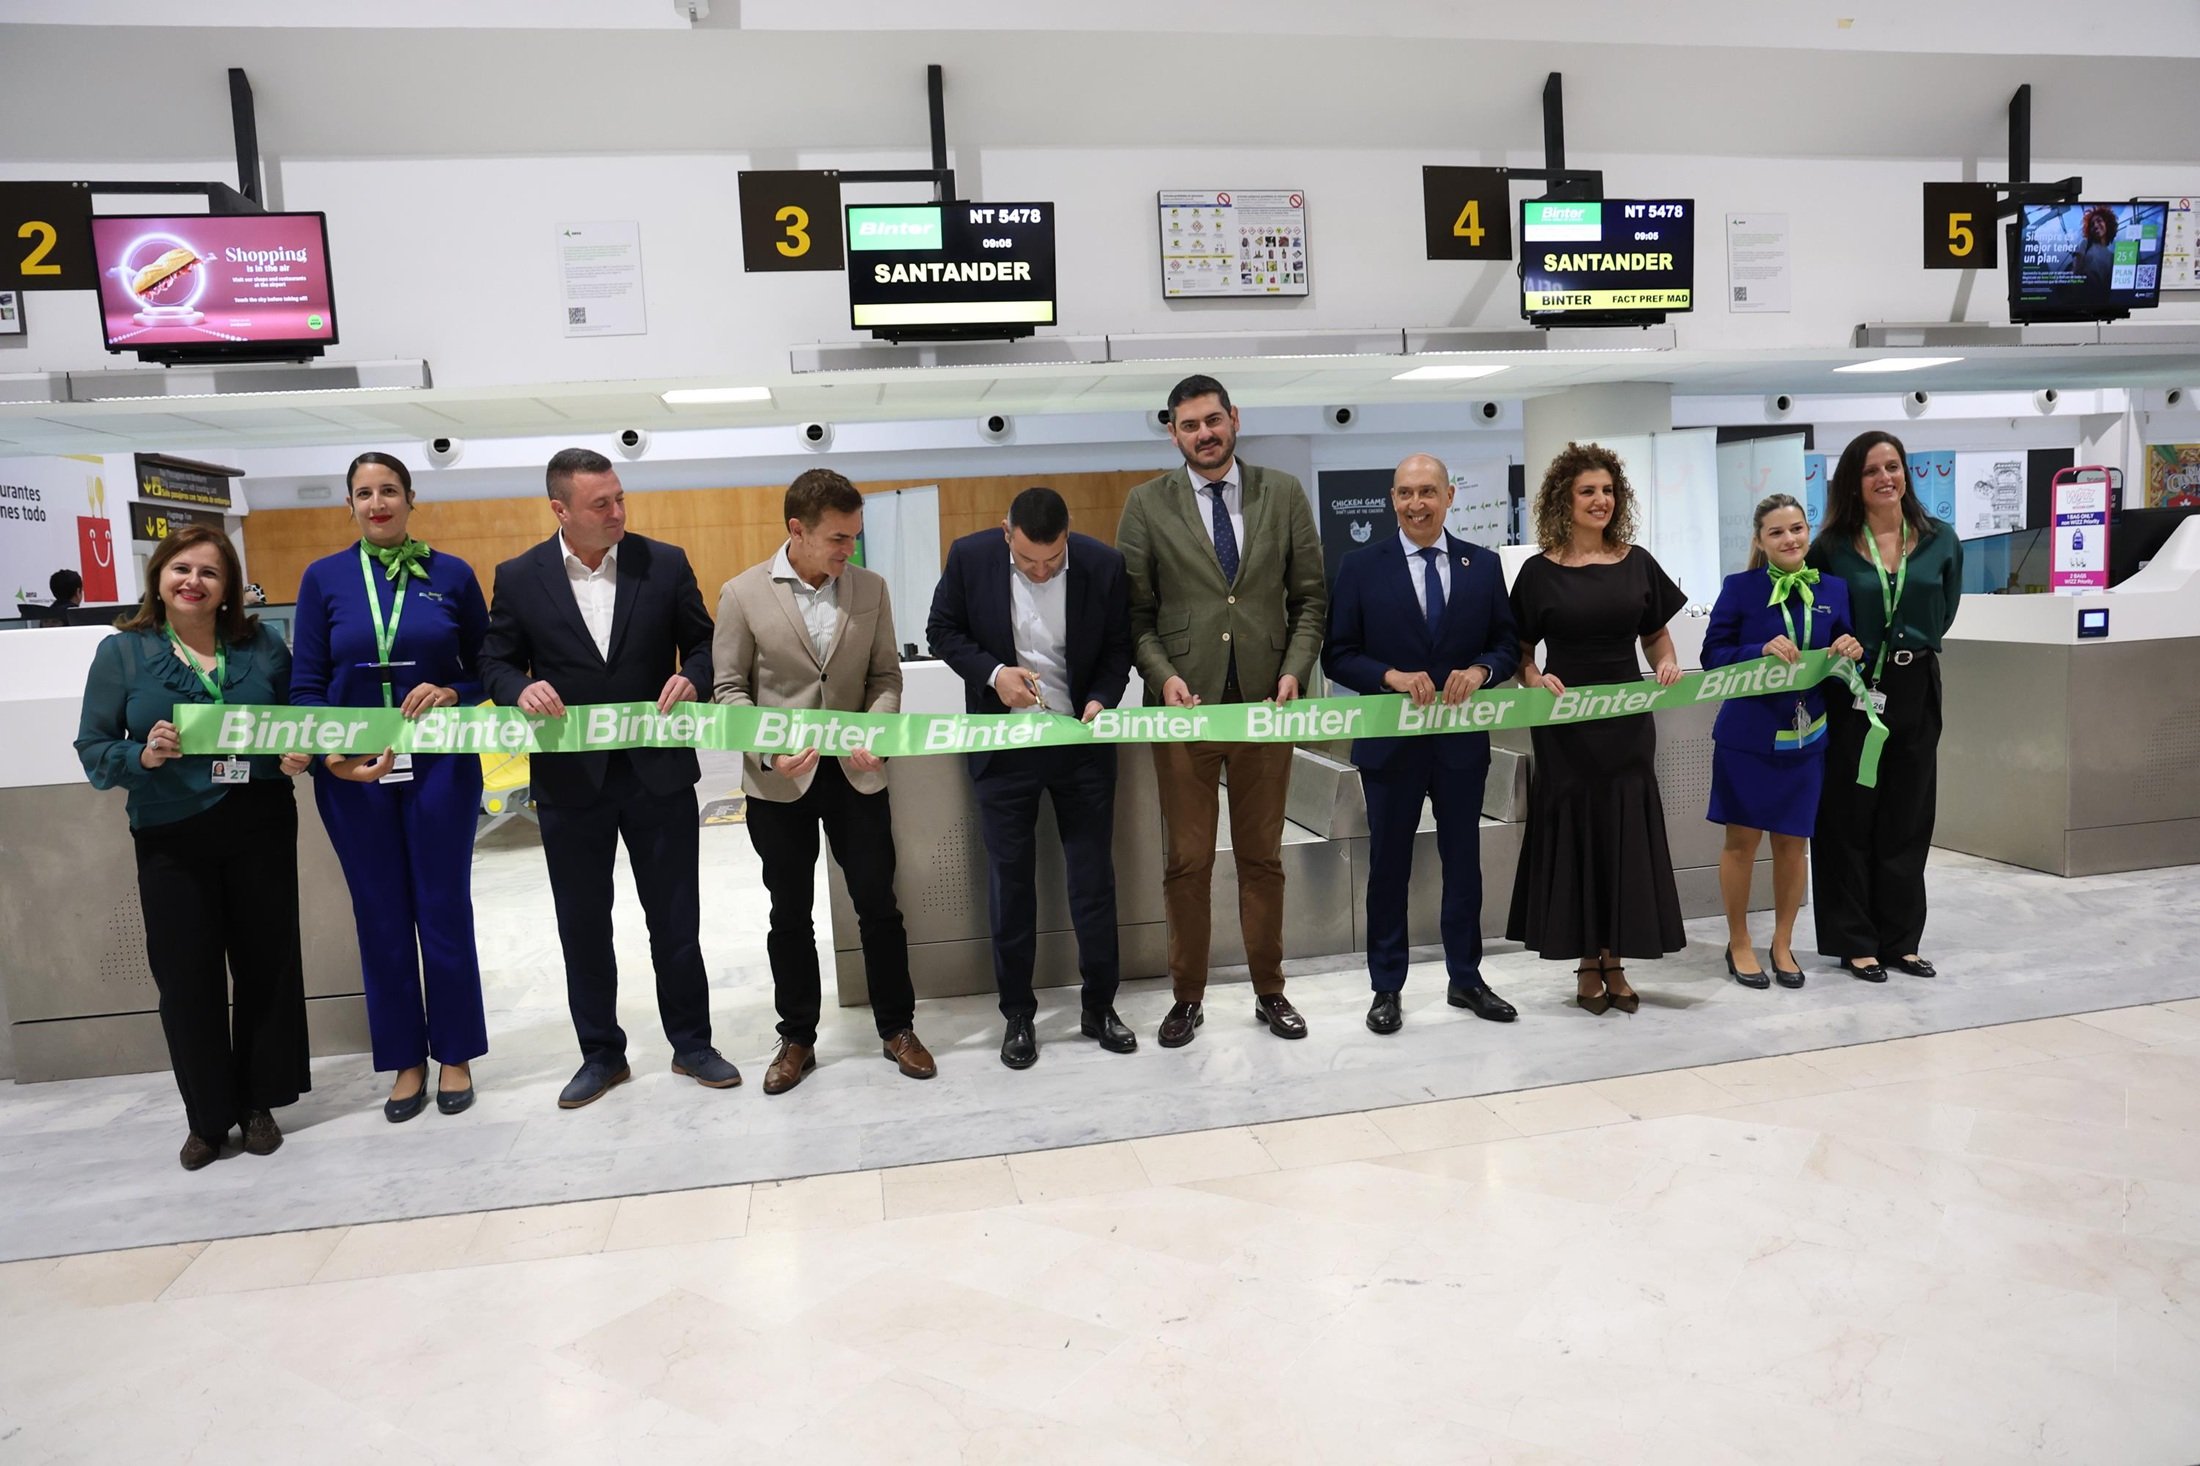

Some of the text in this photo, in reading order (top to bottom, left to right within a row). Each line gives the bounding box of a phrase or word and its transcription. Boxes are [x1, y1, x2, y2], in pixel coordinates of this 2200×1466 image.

[969, 208, 1041, 224] NT 5478
[1541, 206, 1585, 219] Binter
[1624, 205, 1683, 218] NT 5478
[859, 222, 935, 236] Binter
[1453, 200, 1485, 246] 4
[775, 206, 811, 257] 3
[1634, 231, 1659, 240] 09:05
[1948, 212, 1974, 256] 5
[17, 220, 61, 275] 2
[983, 238, 1012, 248] 09:05
[2024, 243, 2078, 254] mejor tener
[225, 246, 308, 266] Shopping
[1544, 253, 1673, 272] SANTANDER
[2023, 253, 2060, 265] un plan.
[2116, 251, 2127, 262] 25
[264, 264, 278, 272] the
[279, 264, 290, 272] air
[874, 262, 1032, 284] SANTANDER
[1542, 294, 1688, 306] BINTER FACT PREF MAD
[1331, 497, 1386, 508] CHICKEN GAME
[22, 505, 46, 521] todo
[217, 711, 368, 749] Binter
[412, 708, 544, 748] Binter
[586, 708, 715, 744] Binter
[754, 712, 885, 750] Binter
[925, 715, 1052, 750] Binter
[1093, 711, 1208, 738] Binter
[1247, 706, 1361, 737] Binter
[1398, 698, 1514, 731] Binter
[1550, 687, 1666, 720] Binter
[1695, 661, 1806, 700] Binter
[1873, 702, 1884, 710] 26
[230, 769, 247, 779] 27
